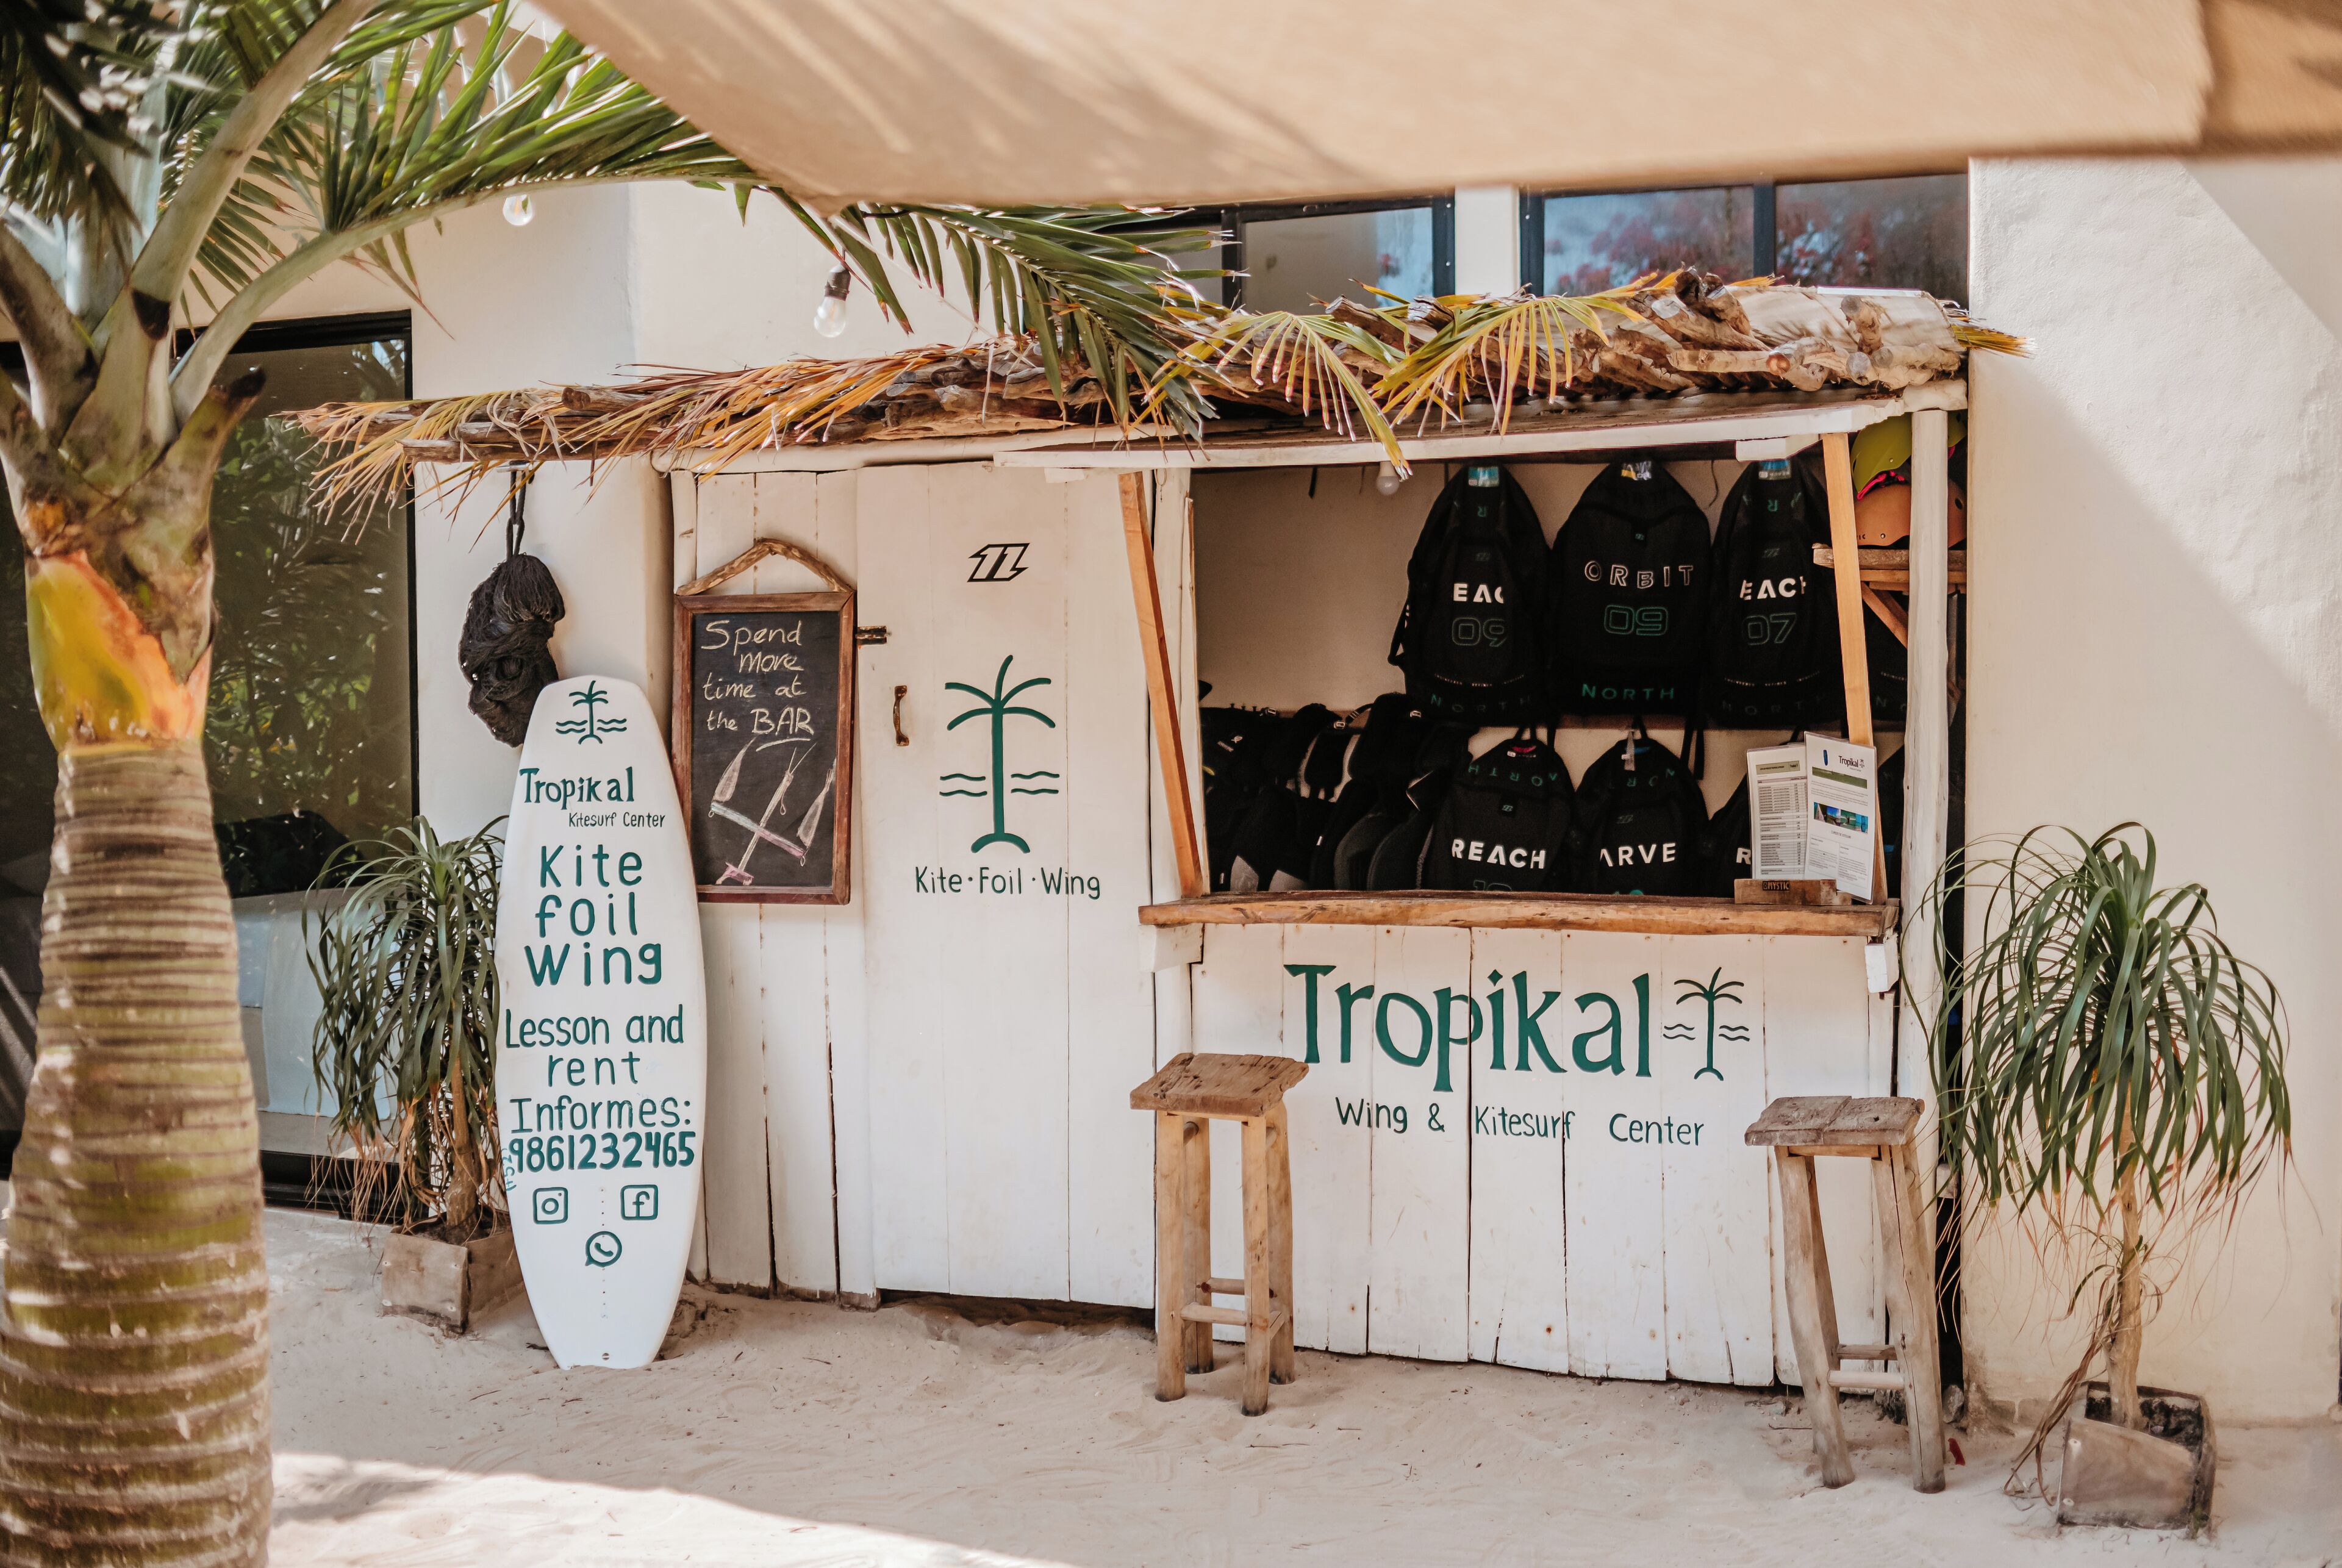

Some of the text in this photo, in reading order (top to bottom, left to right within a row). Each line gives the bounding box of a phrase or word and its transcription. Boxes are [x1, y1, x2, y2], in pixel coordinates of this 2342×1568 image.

[1585, 560, 1694, 589] ORBIT
[1604, 604, 1669, 637] 09
[1742, 613, 1798, 646] 07
[701, 620, 802, 657] Spend
[739, 652, 805, 674] more
[703, 672, 808, 701] time at
[1581, 683, 1675, 702] NORTH
[706, 707, 815, 737] the BAR
[1838, 755, 1859, 768] Tropikal
[519, 767, 634, 811] Tropikal
[568, 812, 665, 828] Kitesurf Center
[539, 844, 642, 888] Kite
[1451, 838, 1547, 870] REACH
[1767, 881, 1791, 890] MYSTIC
[535, 892, 638, 938] foil
[506, 1004, 684, 1048] Lesson and
[1283, 964, 1652, 1092] Tropikal
[548, 1051, 640, 1087] rent
[510, 1094, 691, 1134] Informes:
[1335, 1097, 1704, 1146] Wing & Kitesurf Center
[507, 1131, 696, 1173] 9861232465
